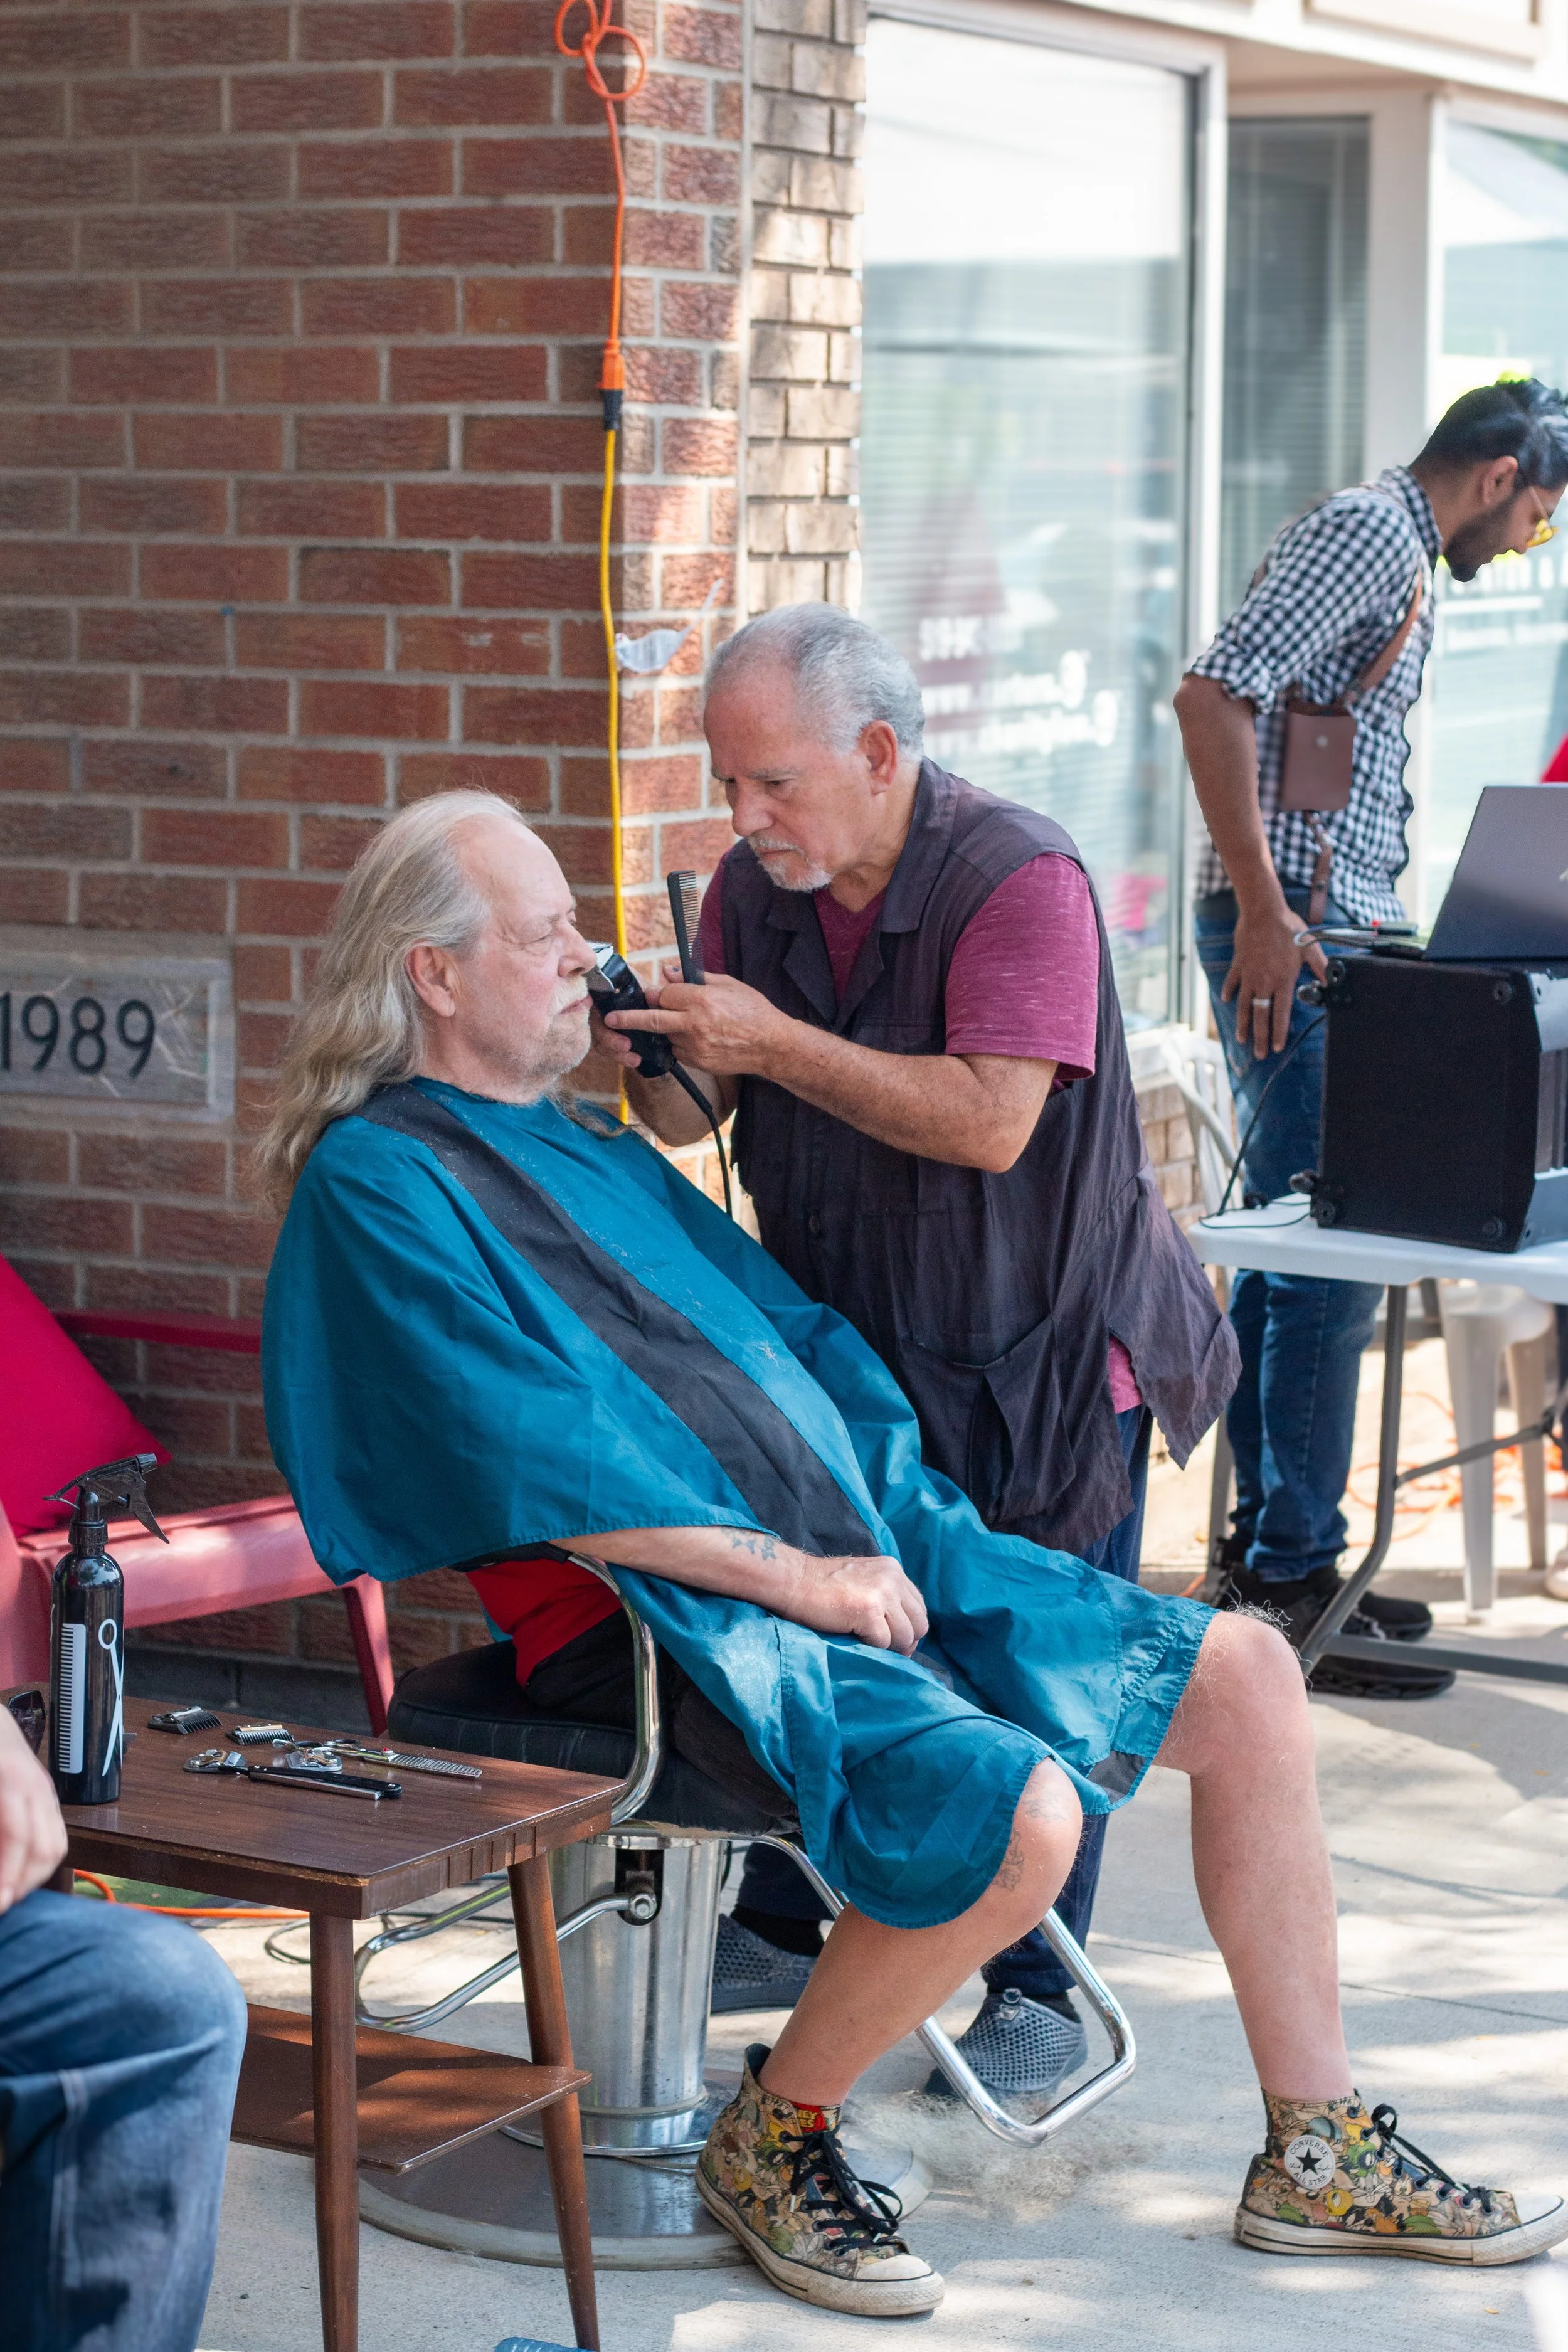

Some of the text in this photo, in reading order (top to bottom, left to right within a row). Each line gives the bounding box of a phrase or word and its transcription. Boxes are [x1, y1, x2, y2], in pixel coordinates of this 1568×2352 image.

[0, 991, 156, 1079] 1989
[1290, 2139, 1329, 2157] CONVERSE
[1293, 2172, 1327, 2186] ALL STAR
